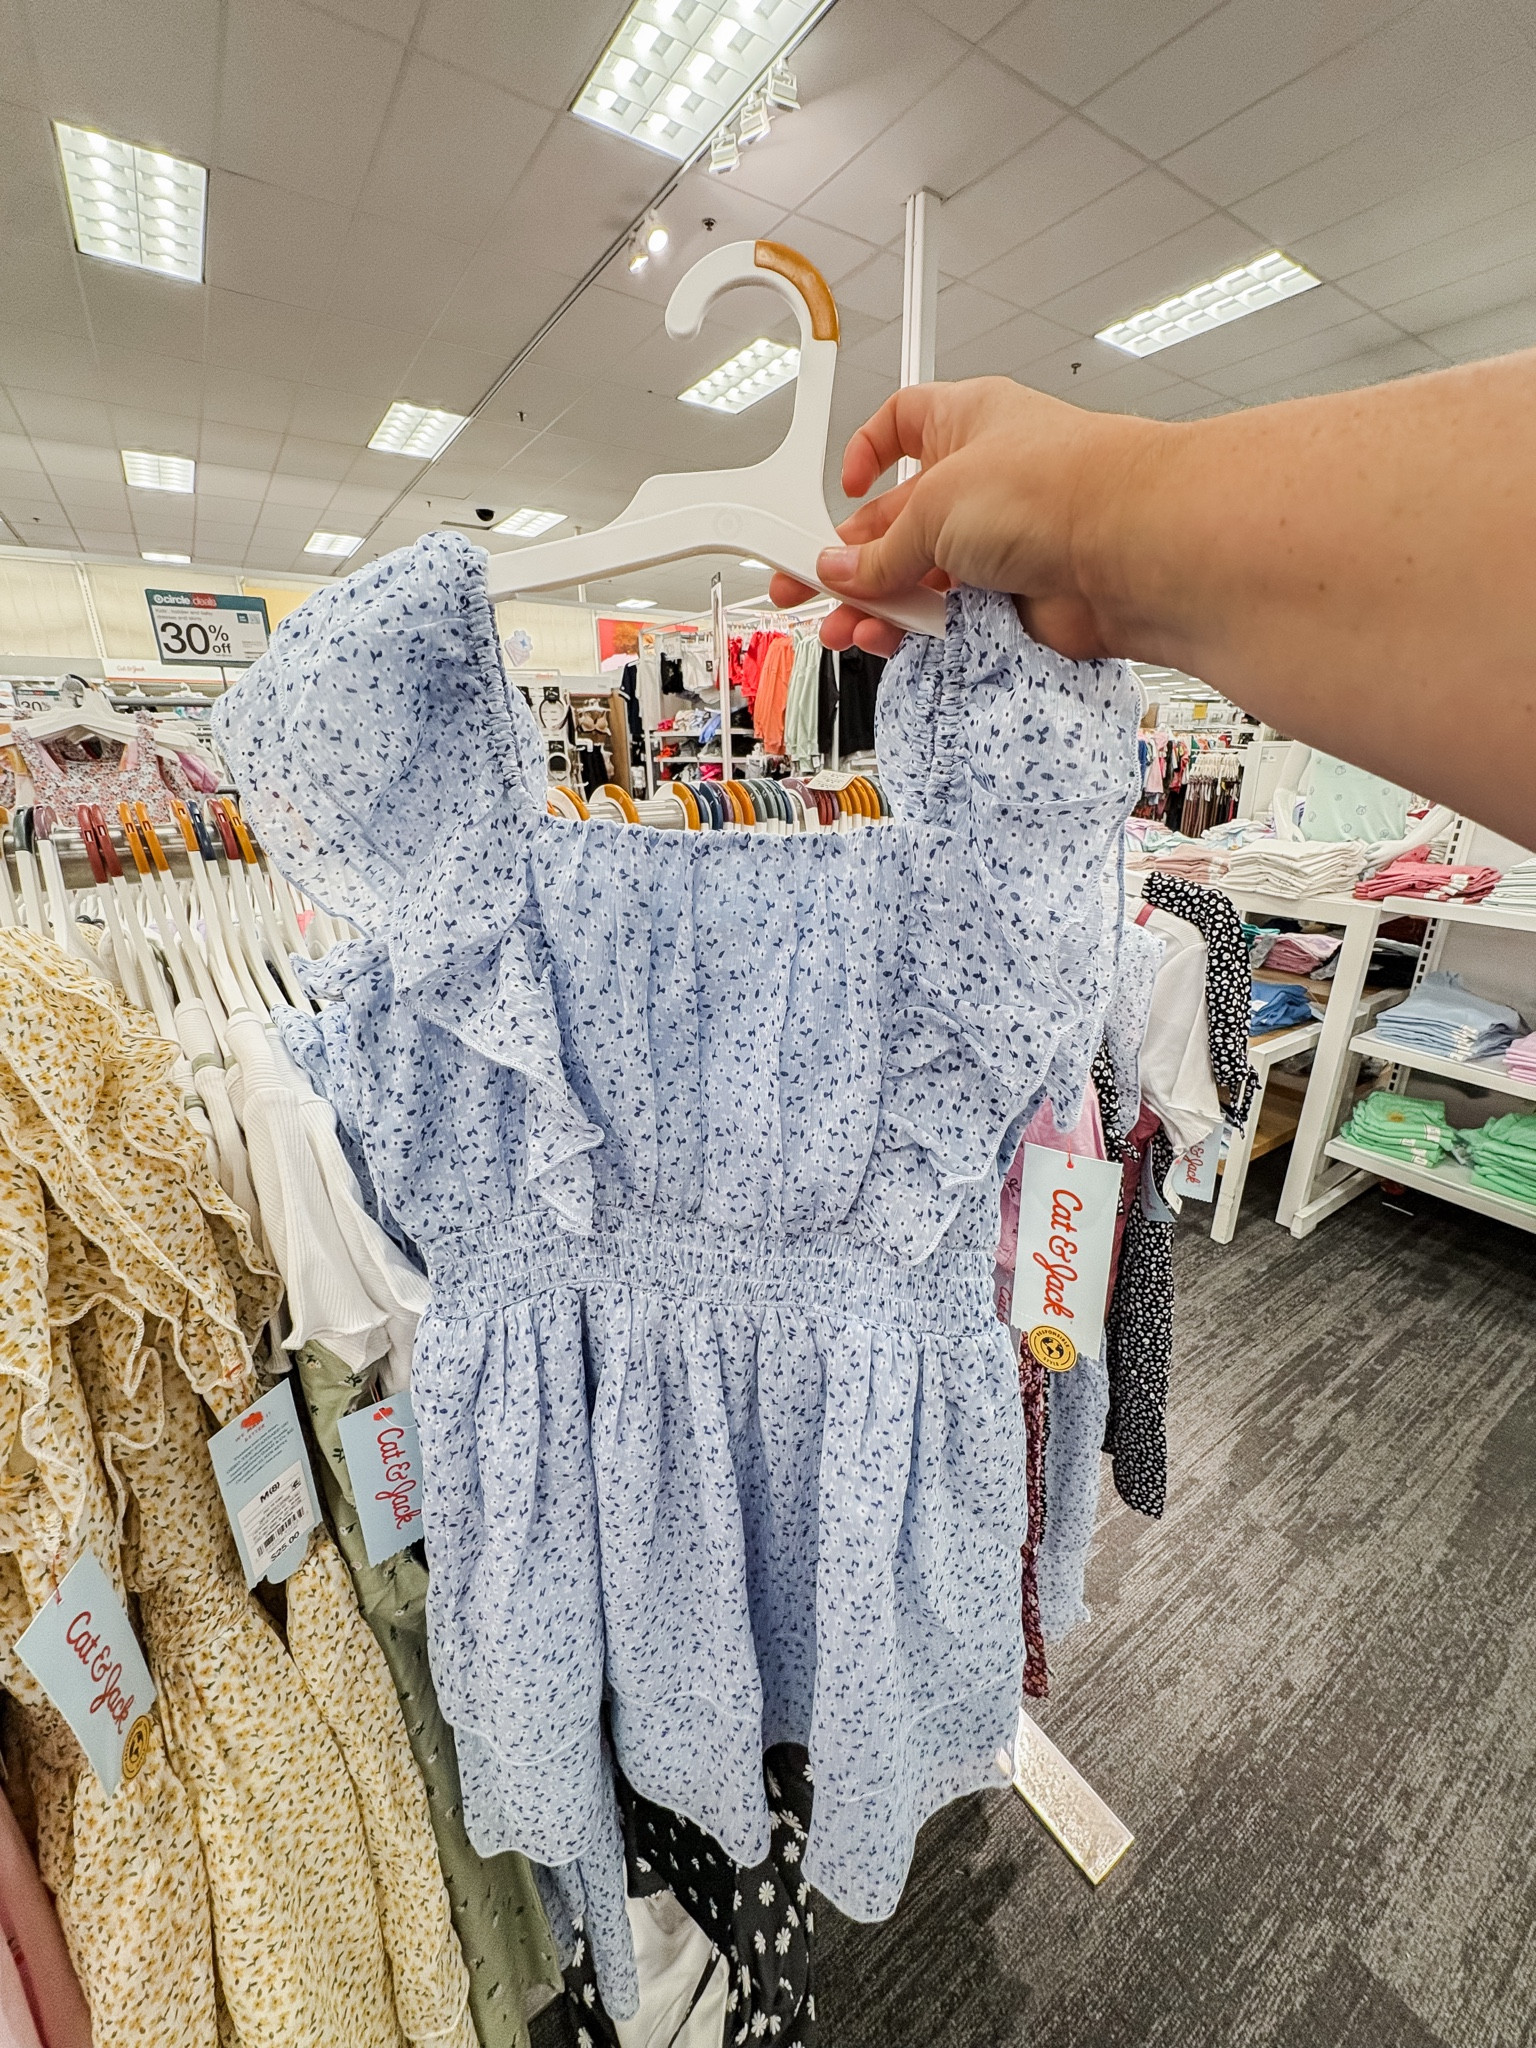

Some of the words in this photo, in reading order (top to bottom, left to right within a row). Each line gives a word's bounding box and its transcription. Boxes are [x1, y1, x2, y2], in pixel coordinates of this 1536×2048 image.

[162, 595, 191, 605] circle
[212, 643, 231, 654] off
[1052, 1189, 1083, 1234] Cat
[1048, 1235, 1078, 1263] &
[1033, 1252, 1078, 1319] Jack
[377, 1428, 406, 1464] Cat
[386, 1461, 410, 1481] &
[375, 1480, 421, 1529] Jack
[66, 1611, 100, 1664] Cat
[91, 1645, 112, 1682] &
[90, 1663, 134, 1734] Jack
